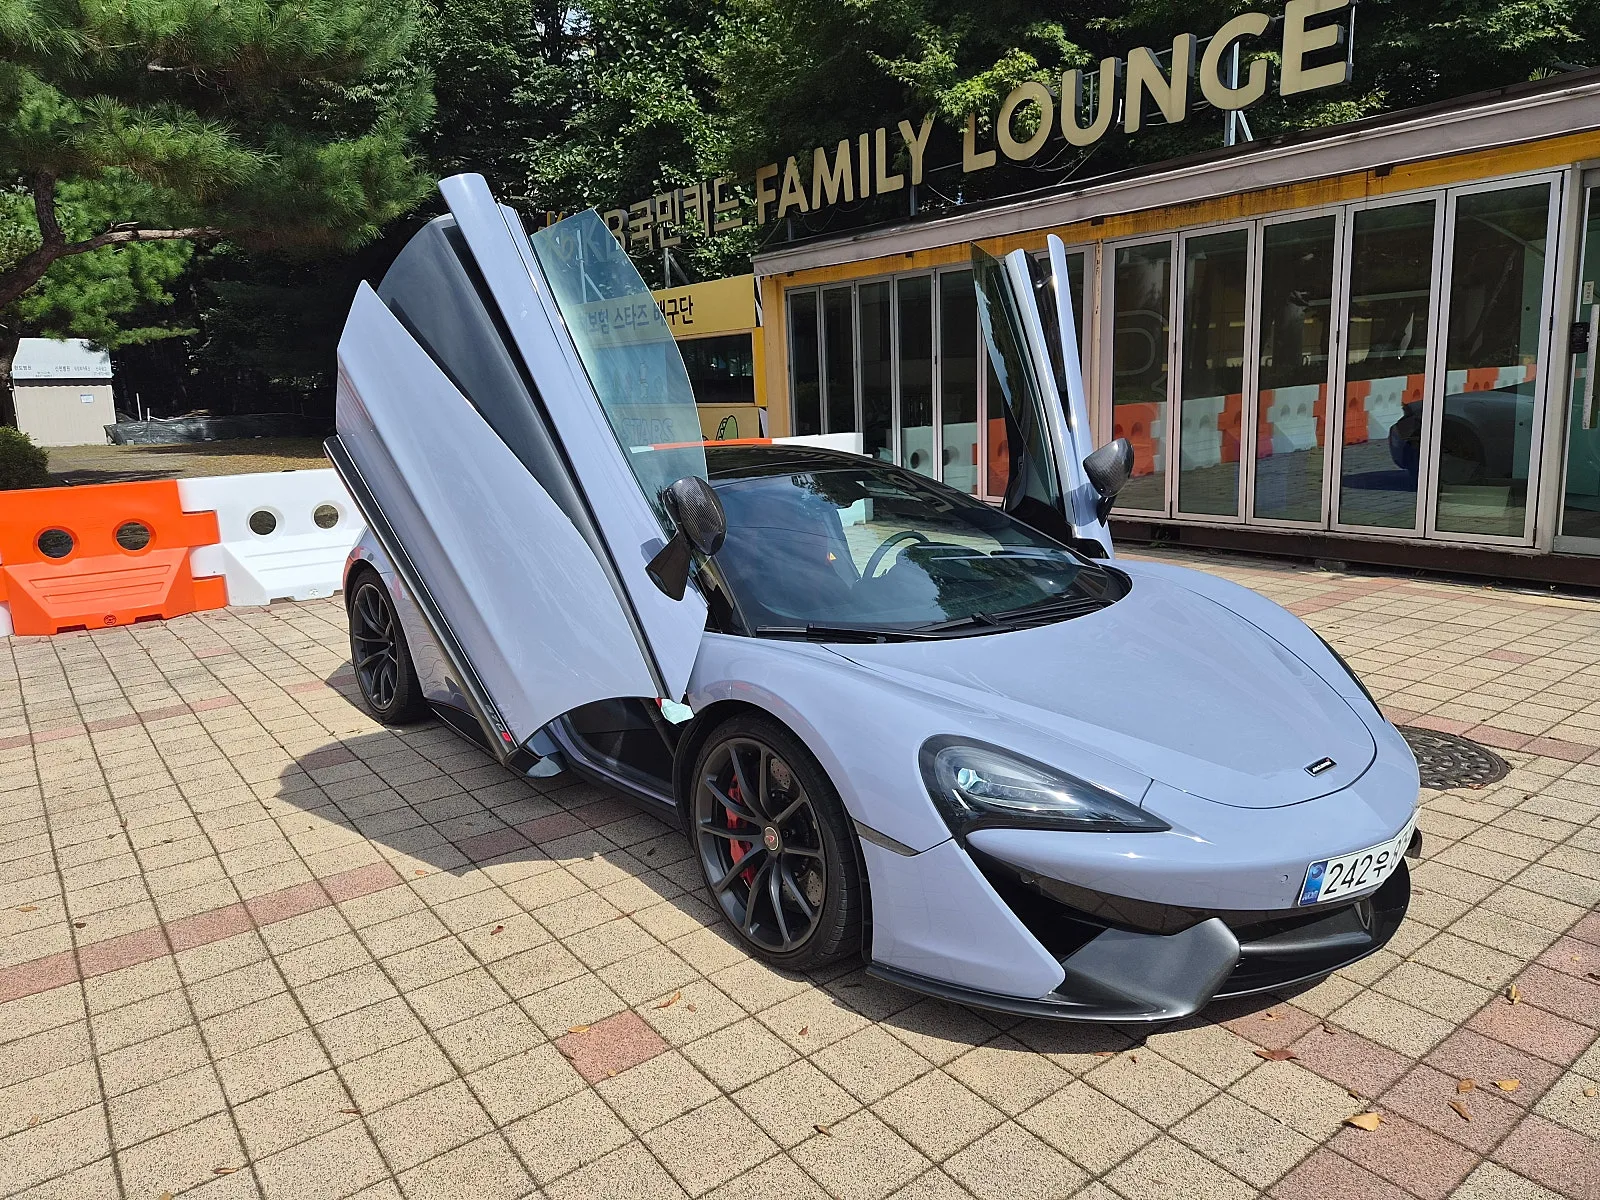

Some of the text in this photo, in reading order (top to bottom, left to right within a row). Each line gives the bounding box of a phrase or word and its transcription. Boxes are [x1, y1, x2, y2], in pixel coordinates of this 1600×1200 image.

[756, 115, 936, 226] FAMILY
[962, 0, 1354, 174] LOUNGE
[613, 303, 650, 331] 스타즈
[654, 295, 694, 327] 배구단
